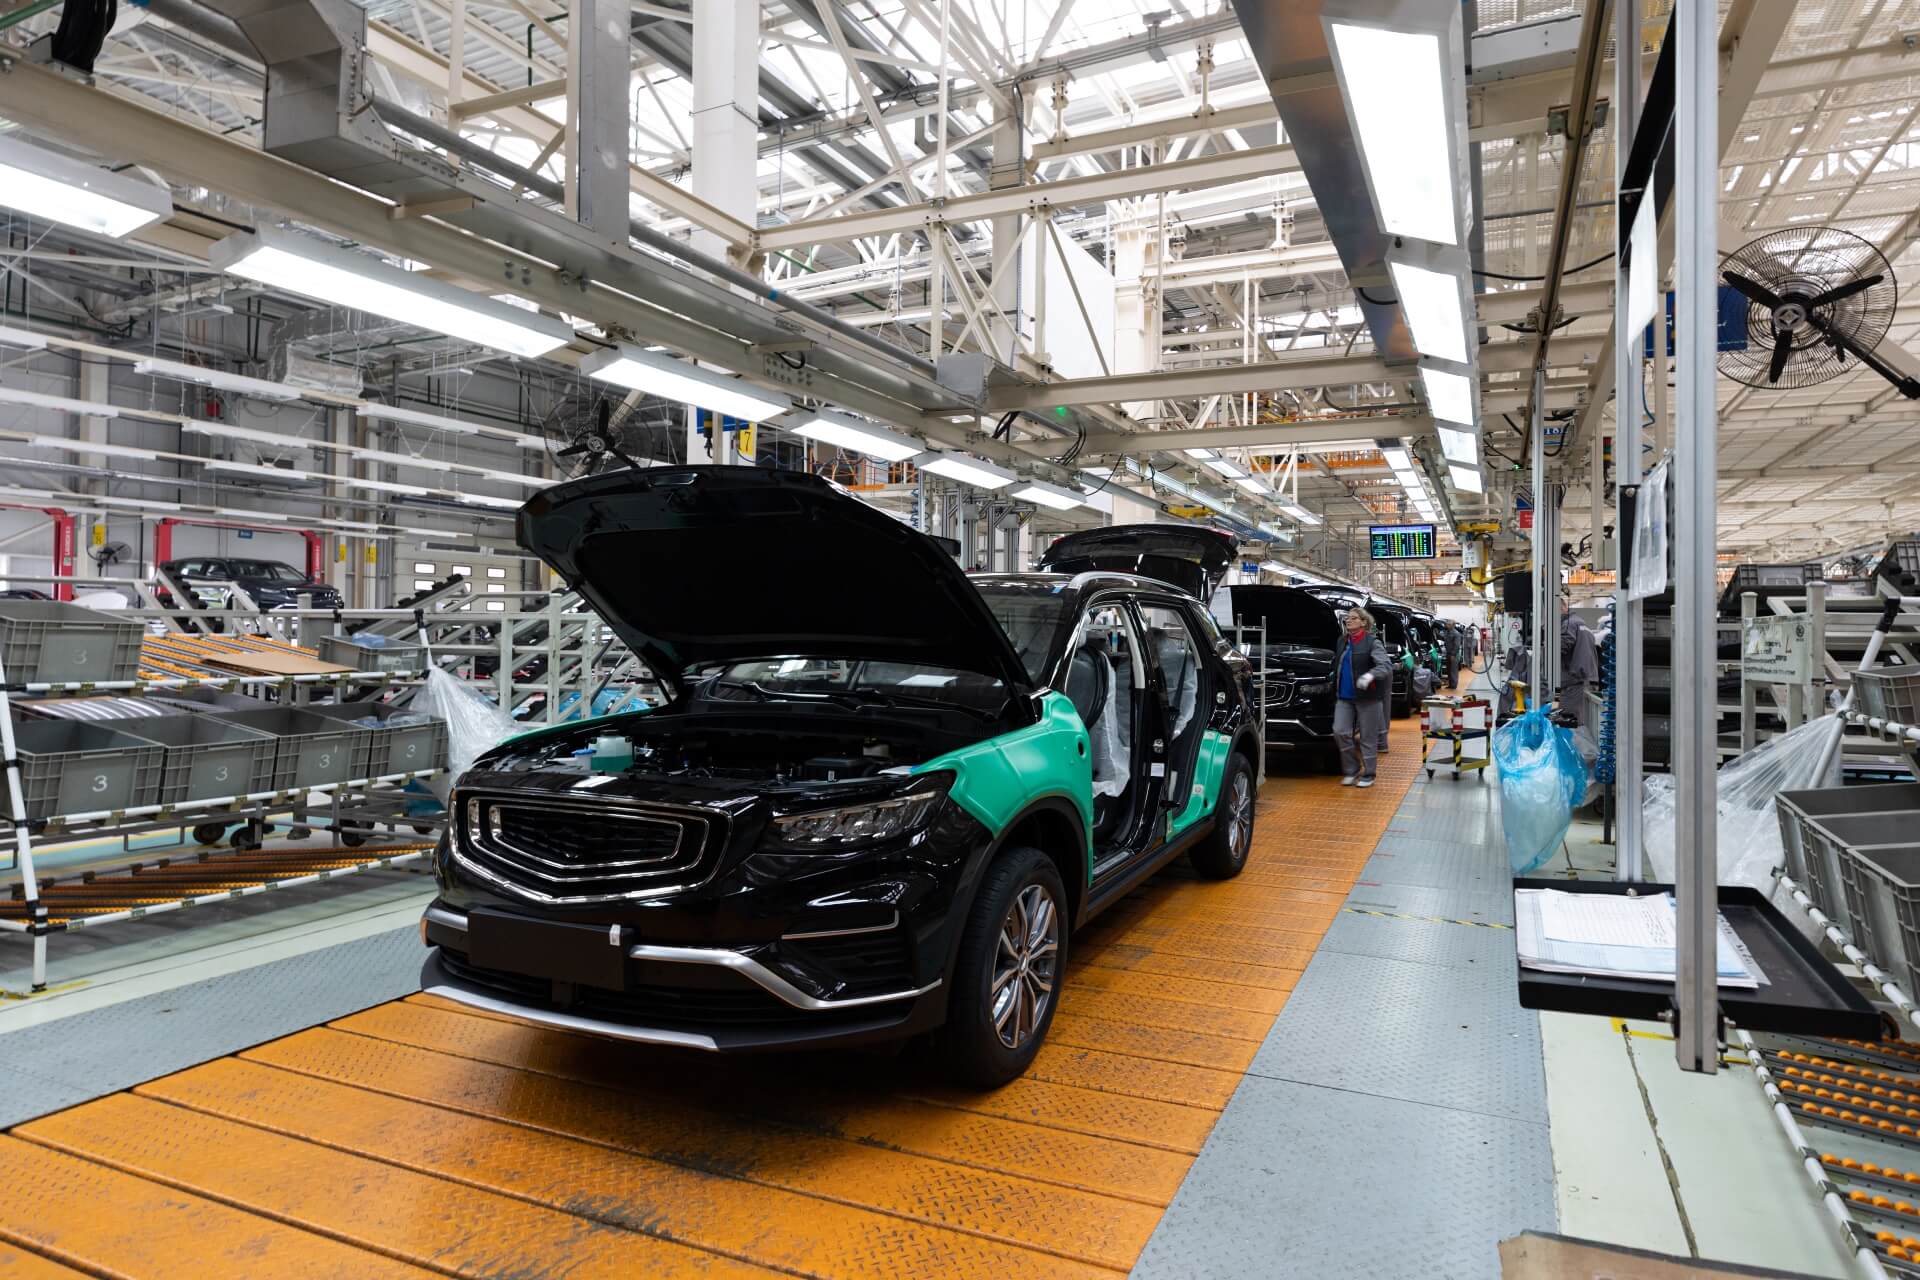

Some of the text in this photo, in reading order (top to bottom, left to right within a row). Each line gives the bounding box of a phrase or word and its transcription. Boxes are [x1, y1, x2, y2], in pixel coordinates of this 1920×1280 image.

[74, 648, 88, 665] 3
[406, 744, 417, 758] 3
[319, 753, 330, 769] 3
[215, 766, 228, 782] 3
[92, 774, 108, 792] 3
